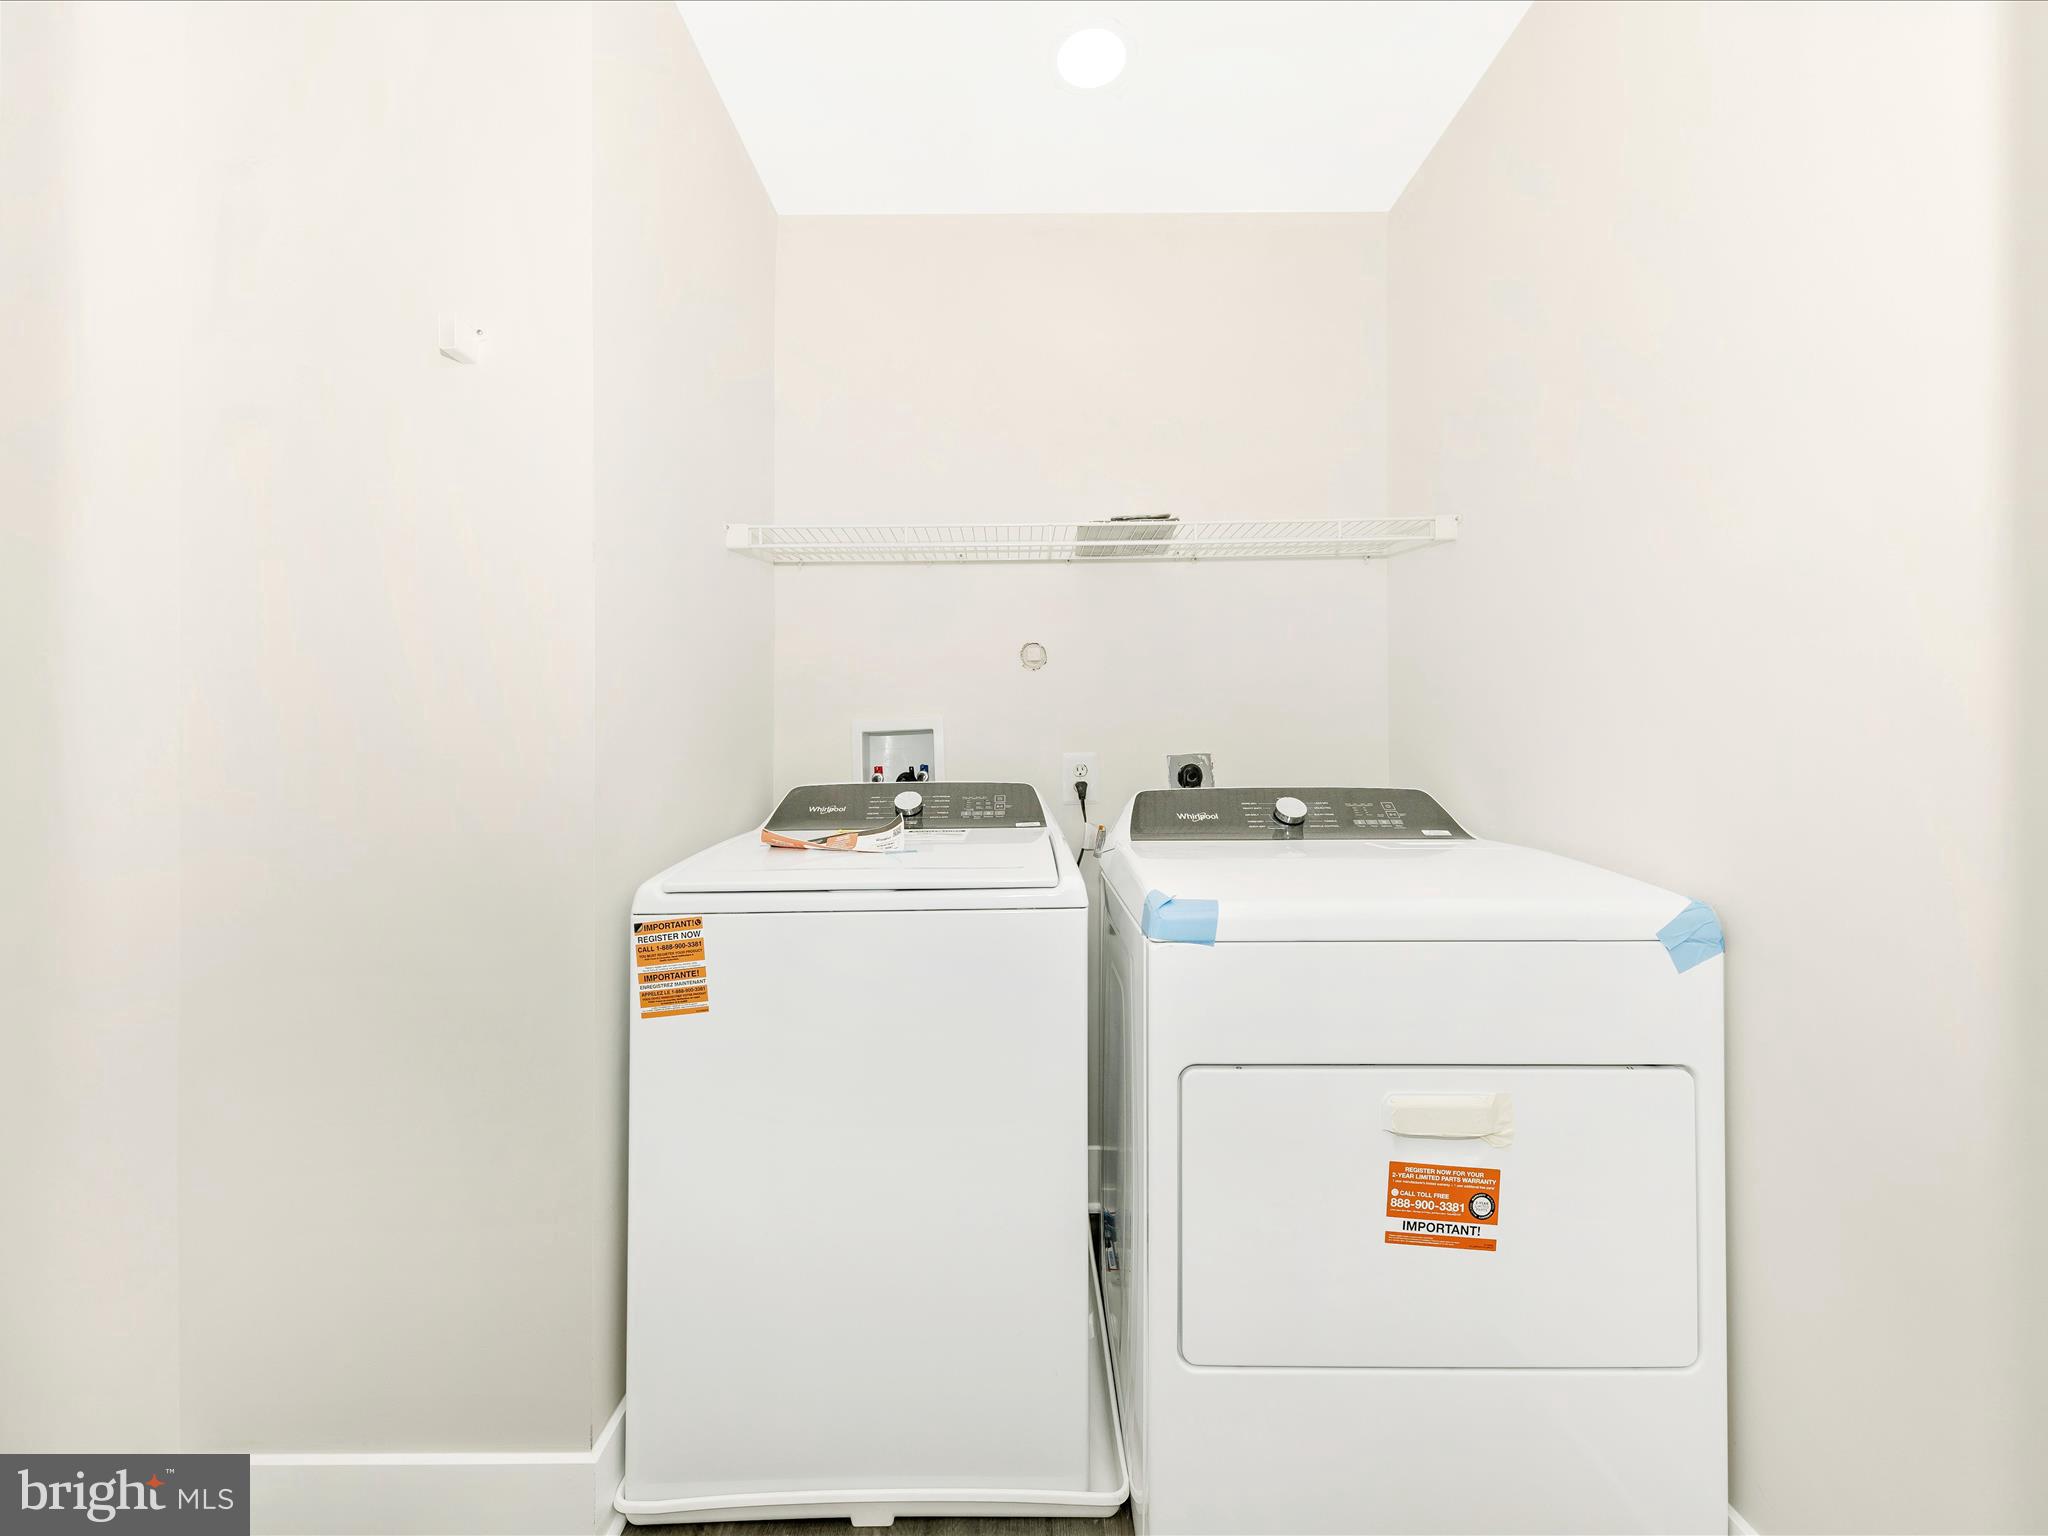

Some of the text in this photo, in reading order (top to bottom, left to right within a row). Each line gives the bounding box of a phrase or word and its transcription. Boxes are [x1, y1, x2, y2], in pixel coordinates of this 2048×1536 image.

[808, 804, 847, 815] Whirlpool
[1176, 811, 1219, 823] Whirlpool
[643, 919, 695, 932] IMPORTANT!
[637, 930, 701, 944] REGISTER NOW
[643, 969, 700, 982] IMPORTANTE!
[1390, 1197, 1466, 1213] 888-900-3381
[1402, 1220, 1482, 1237] IMPORTANT!
